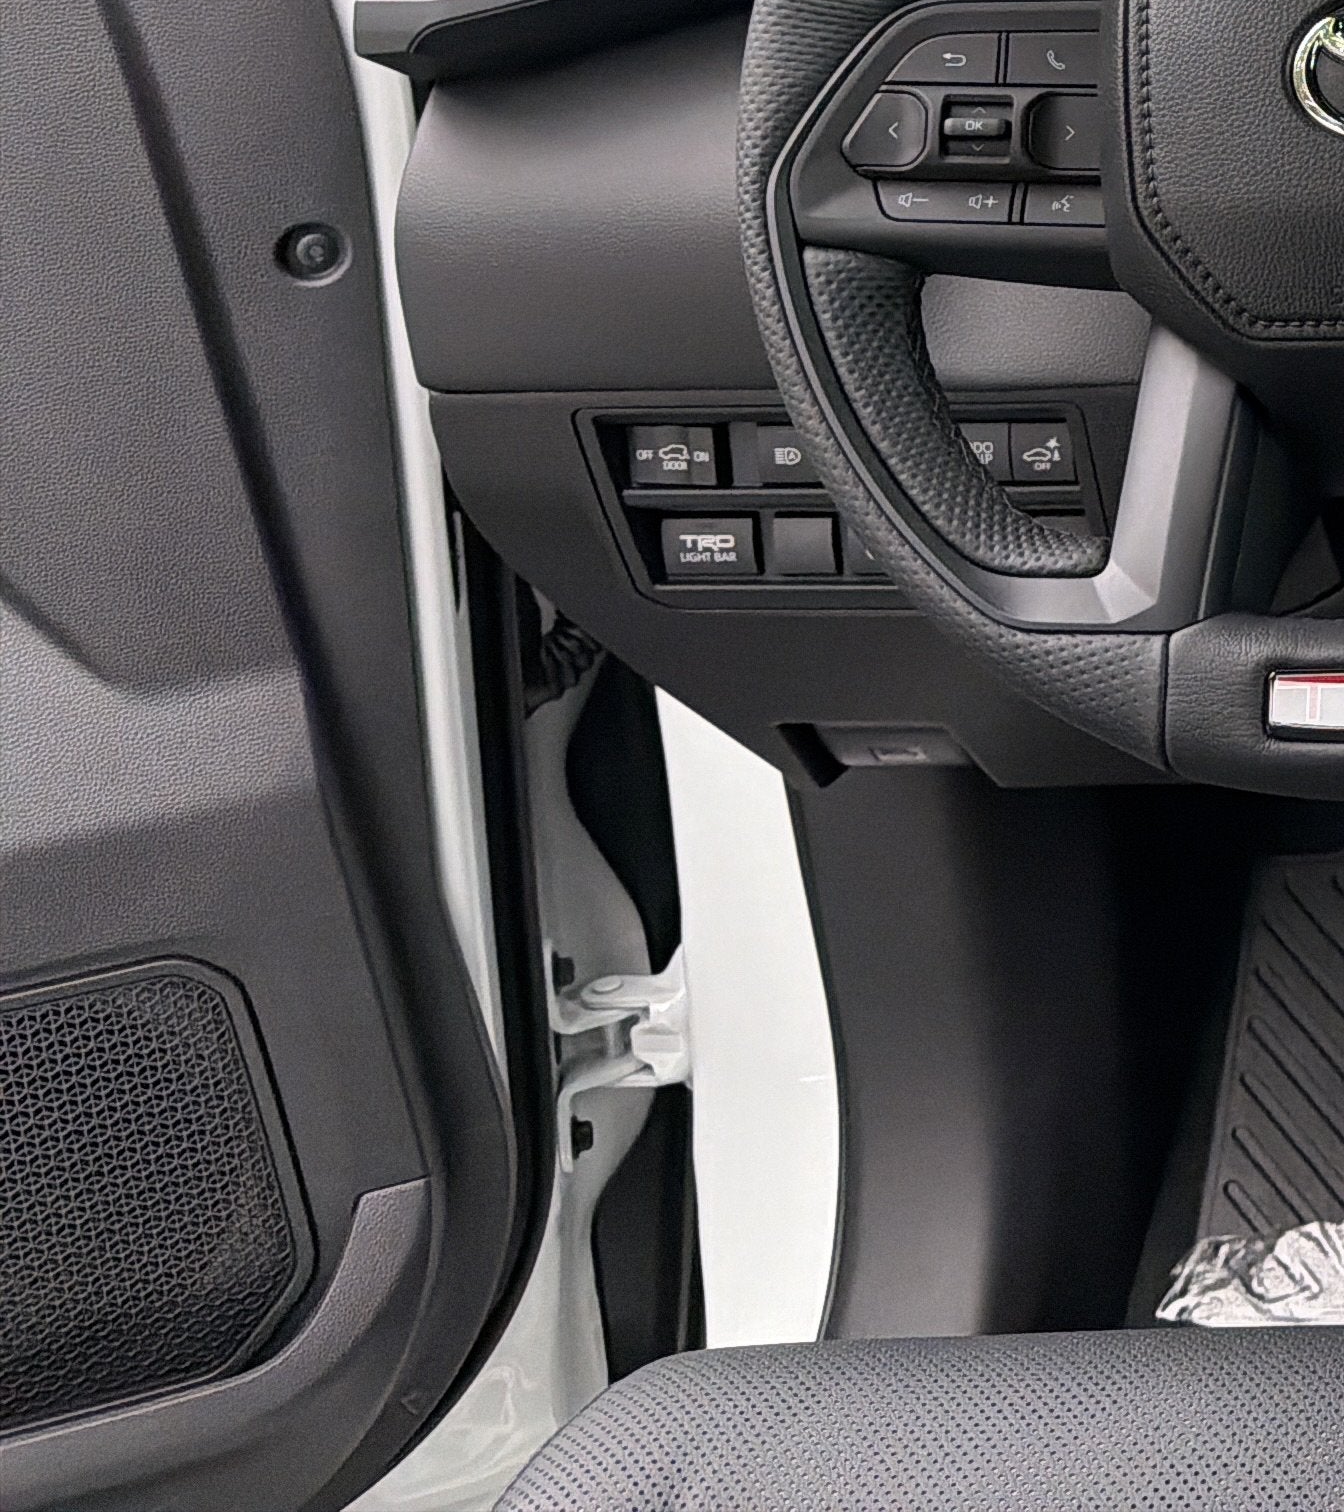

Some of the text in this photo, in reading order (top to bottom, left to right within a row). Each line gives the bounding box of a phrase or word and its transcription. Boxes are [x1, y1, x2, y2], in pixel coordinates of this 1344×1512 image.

[965, 120, 984, 131] OK
[636, 449, 654, 461] OFF
[693, 450, 710, 463] ON
[662, 460, 688, 471] DOOR
[1033, 462, 1052, 471] OFF
[678, 534, 736, 552] TRD
[679, 551, 738, 563] LIGHT BAR
